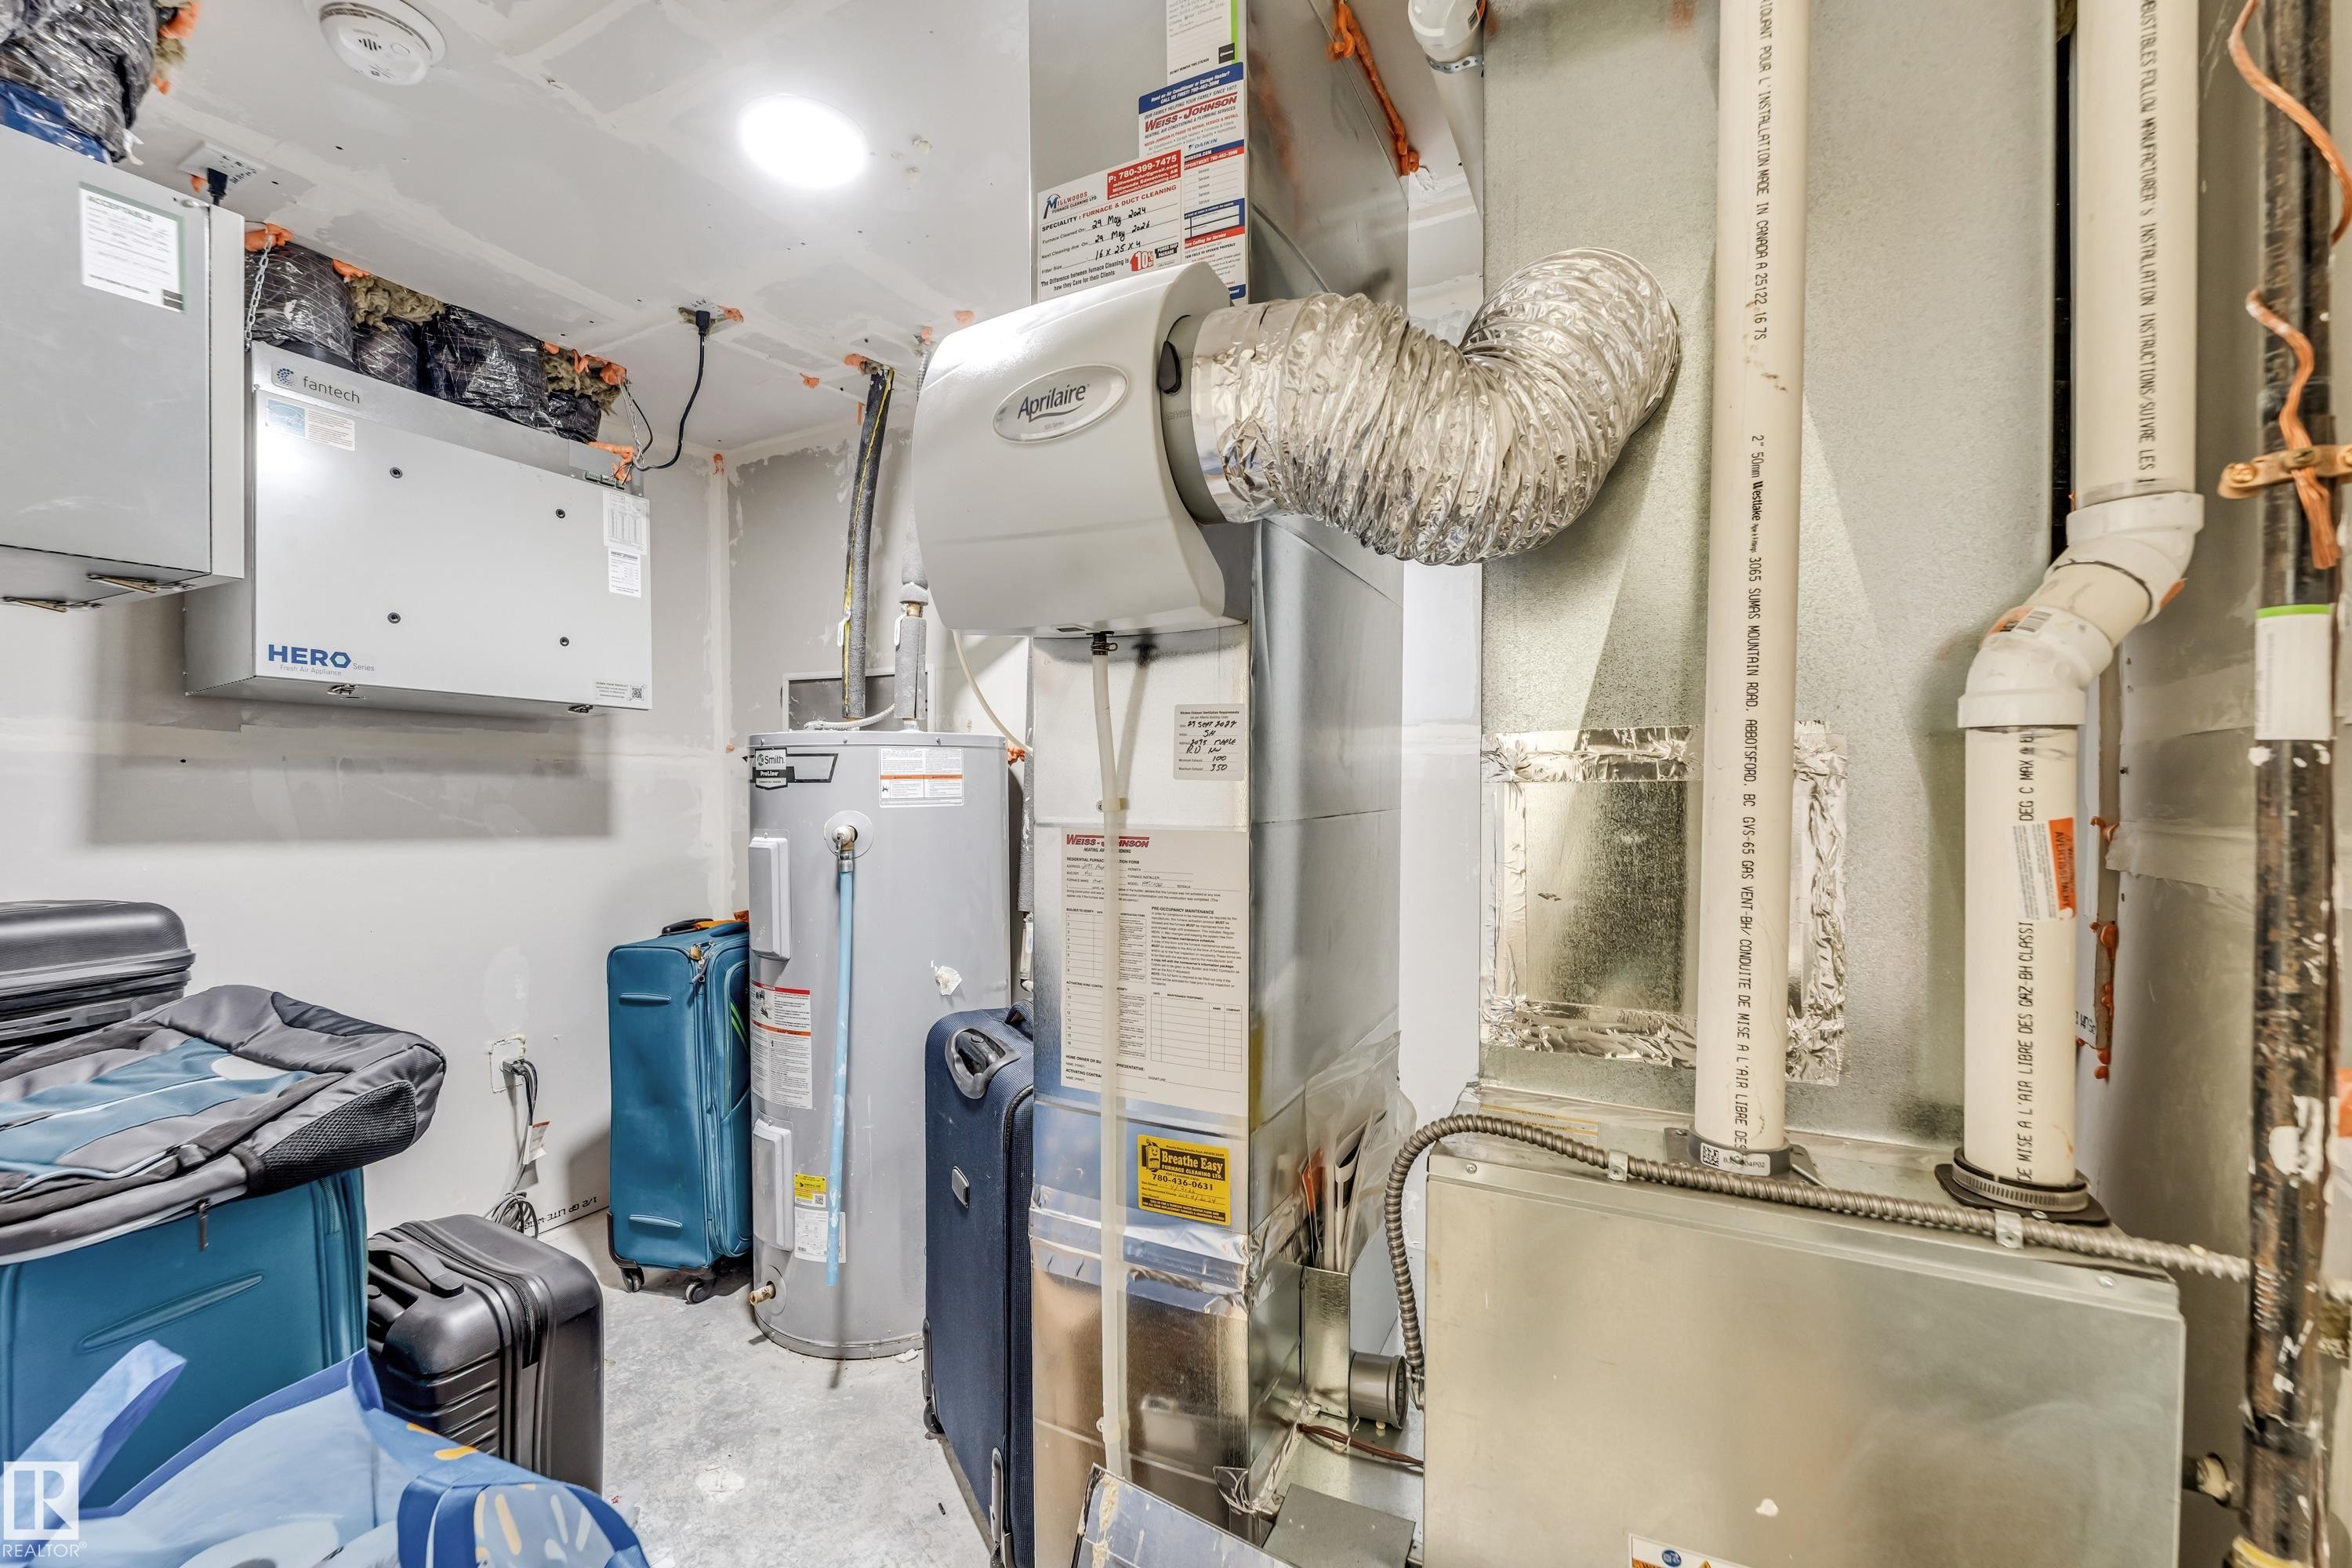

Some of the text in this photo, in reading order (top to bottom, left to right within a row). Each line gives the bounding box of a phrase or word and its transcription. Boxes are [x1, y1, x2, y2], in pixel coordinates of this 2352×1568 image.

[1759, 0, 1775, 40] IQUANT
[2139, 0, 2158, 67] BUSTIBLES
[1758, 45, 1775, 73] POUR
[1160, 96, 1171, 104] CALL
[2139, 68, 2158, 114] FOLLOW
[1153, 108, 1167, 117] FAMILY
[1168, 103, 1185, 111] HELPING
[1197, 92, 1212, 100] FAMILY
[1167, 118, 1193, 131] CONDITIONING
[1197, 111, 1217, 121] PLUMBING
[1217, 106, 1236, 115] SERVICES
[1194, 138, 1218, 149] DAIKIN
[1108, 154, 1177, 183] P: 780-399-7475
[1112, 182, 1139, 193] Millwoods
[1755, 169, 1770, 197] MADE
[1041, 184, 1177, 232] SPECIALITY FURNACE DUCT CLEANING
[1045, 191, 1088, 213] MILLWOODS
[1051, 198, 1089, 214] FURNACE CLEANING
[1755, 201, 1769, 216] IN
[1091, 219, 1102, 230] 29
[1128, 206, 1146, 219] 2024
[1042, 236, 1060, 245] Furnace
[1060, 230, 1078, 239] Cleaned
[1094, 234, 1104, 244] 29
[1131, 220, 1150, 234] 2026
[1755, 220, 1769, 260] CANADA
[1051, 246, 1071, 257] Cleaning
[1095, 249, 1103, 261] 16
[1114, 243, 1126, 255] 25
[2138, 221, 2158, 307] INSTALLATION
[1049, 274, 1070, 285] Difference
[1070, 269, 1087, 279] between
[1088, 264, 1105, 274] furnace
[1105, 260, 1124, 269] Cleaning
[1100, 270, 1115, 279] Clients
[1755, 273, 1769, 306] 25122
[1749, 312, 1769, 324] 16
[1755, 327, 1767, 340] 7S
[303, 376, 361, 404] fantech
[1017, 383, 1087, 423] Aprilaire
[1750, 452, 1765, 478] 50mm
[2137, 448, 2157, 470] LES
[1751, 481, 1763, 521] Westlake
[1747, 557, 1763, 582] 3065
[1746, 588, 1763, 619] SUMAS
[268, 644, 375, 672] HERO Series
[1746, 625, 1762, 676] MOUNTAIN
[311, 666, 342, 677] Appliance
[764, 755, 784, 764] Smith
[2018, 760, 2035, 781] MAX
[1742, 793, 1757, 808] BC
[2017, 800, 2034, 822] DEG
[1741, 816, 1757, 855] GVS-65
[1740, 860, 1754, 880] GAS
[1737, 938, 1752, 989] CONDUITE
[2017, 965, 2034, 1007] GAZ-BH
[1737, 994, 1751, 1008] DE
[1737, 1013, 1751, 1040] MISE
[2016, 1013, 2034, 1035] DES
[2016, 1040, 2034, 1076] LIBRE
[1736, 1057, 1749, 1088] L'AIR
[1734, 1094, 1748, 1126] LIBRE
[2016, 1080, 2034, 1116] L'AIR
[2016, 1121, 2033, 1130] A
[2016, 1134, 2033, 1163] MISE
[1161, 1150, 1199, 1168] Breathe
[1200, 1157, 1223, 1174] Easy
[1161, 1164, 1185, 1173] FURNACE
[1185, 1168, 1211, 1178] CLEANING
[1152, 1173, 1214, 1191] 780-436-0631
